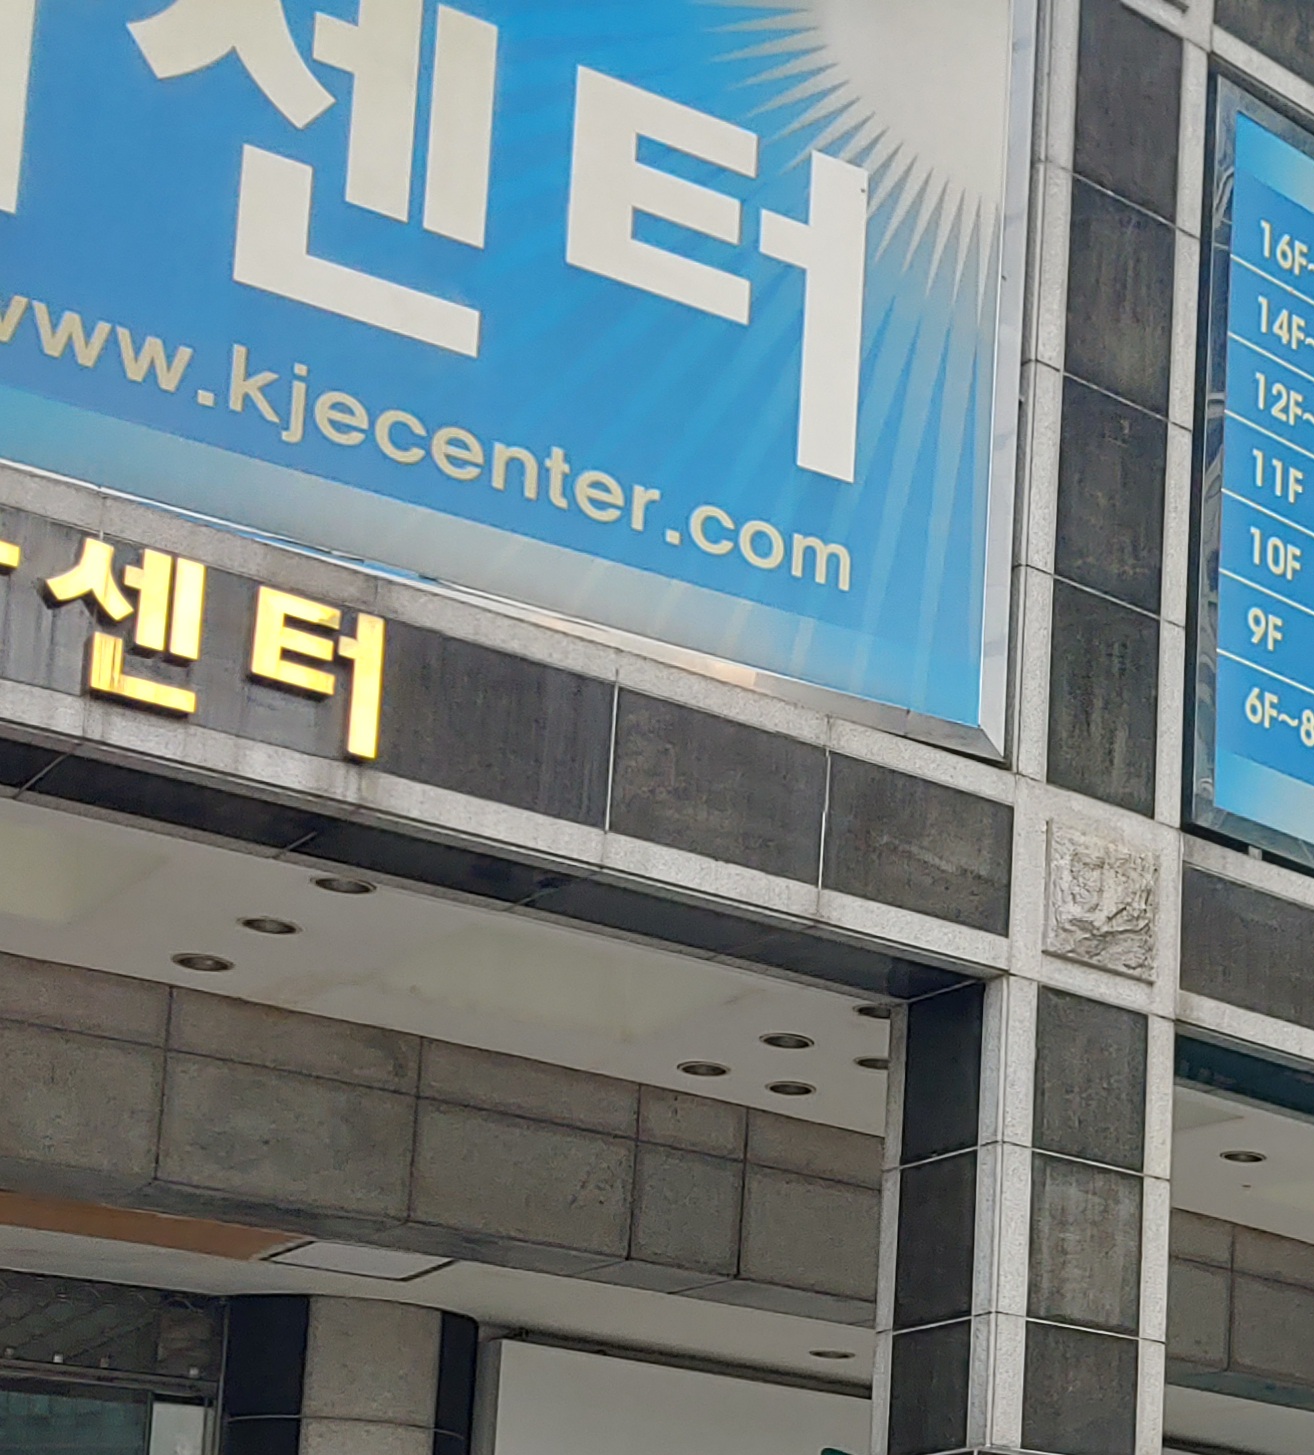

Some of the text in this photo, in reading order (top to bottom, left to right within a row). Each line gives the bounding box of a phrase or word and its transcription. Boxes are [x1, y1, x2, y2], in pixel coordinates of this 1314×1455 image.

[1252, 448, 1304, 503] 11F
[1249, 525, 1302, 581] 10F
[0, 537, 385, 759] 센터
[1247, 606, 1284, 652] 9F
